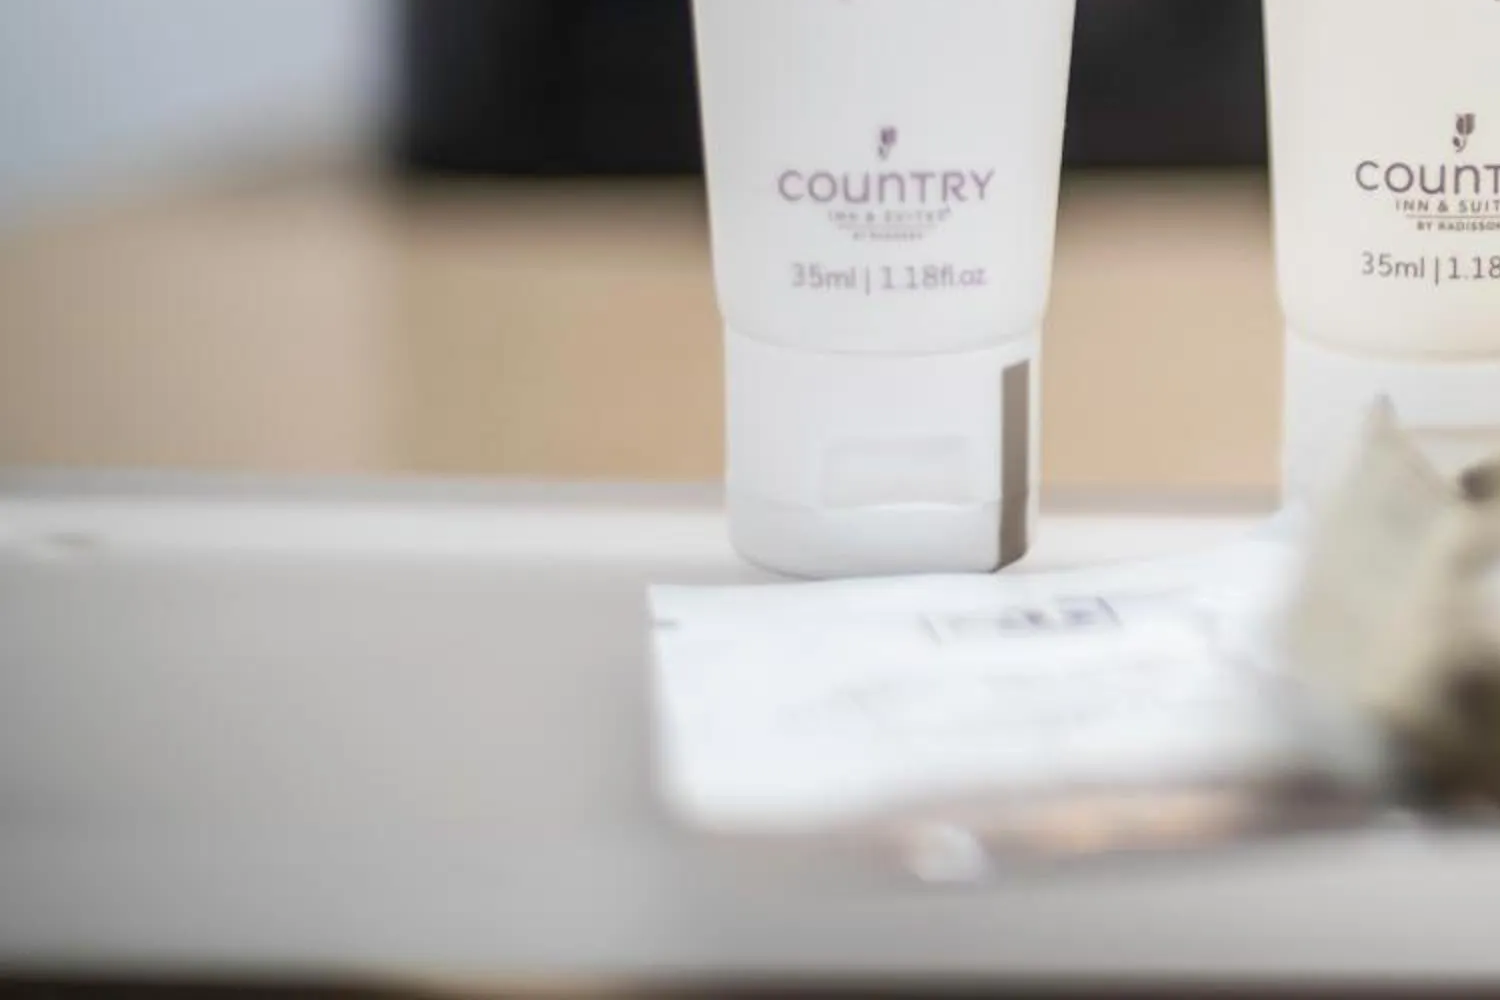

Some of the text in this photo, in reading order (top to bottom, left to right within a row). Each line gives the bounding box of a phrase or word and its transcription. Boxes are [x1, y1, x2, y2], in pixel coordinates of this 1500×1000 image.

[1395, 200, 1429, 213] INN
[1416, 221, 1432, 232] BY
[1361, 251, 1426, 279] 35ml
[790, 262, 858, 291] 35ml
